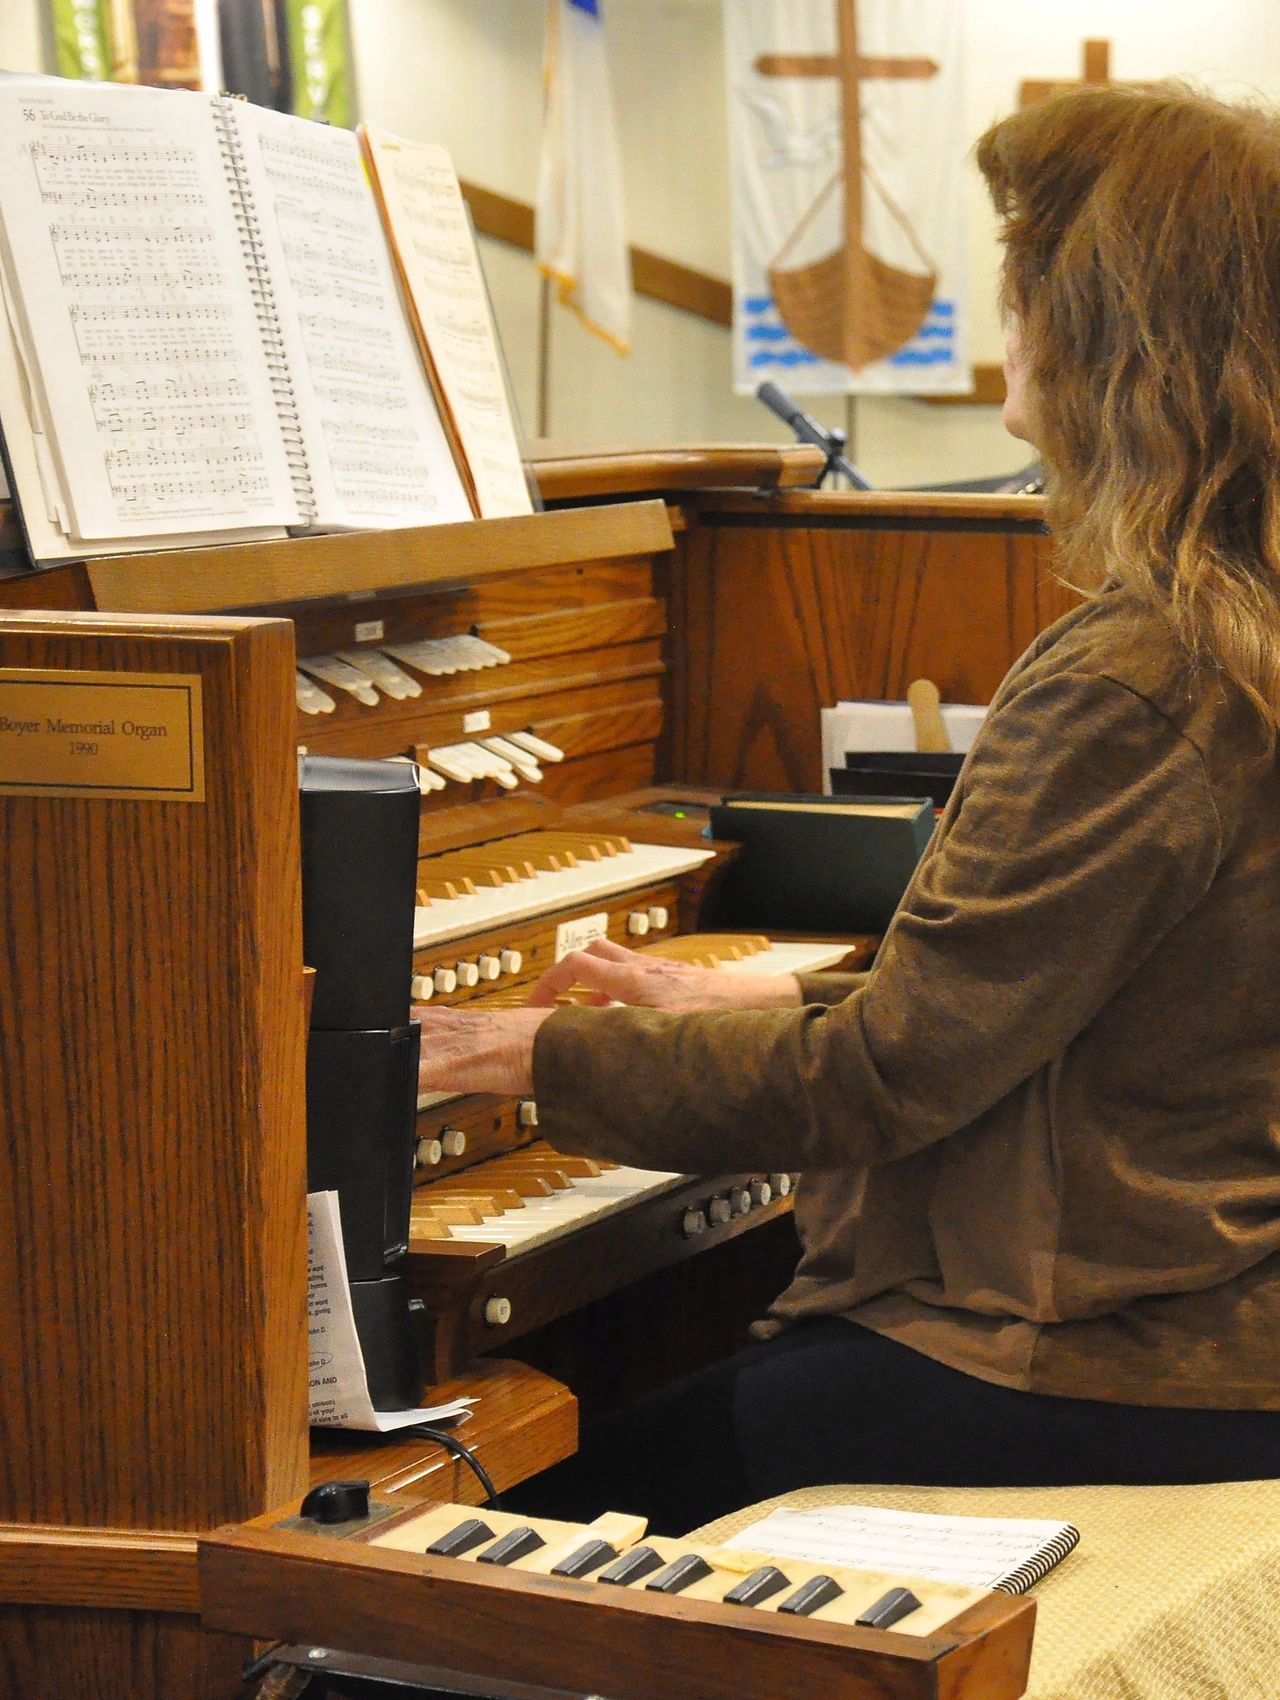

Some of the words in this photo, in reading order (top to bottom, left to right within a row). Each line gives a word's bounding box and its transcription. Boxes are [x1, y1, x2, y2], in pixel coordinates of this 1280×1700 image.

[23, 108, 36, 122] 56
[50, 110, 66, 121] God
[0, 716, 40, 736] Boyer
[46, 718, 115, 735] Memorial
[122, 721, 167, 740] Organ
[70, 742, 98, 755] 1990
[322, 1376, 338, 1385] AND
